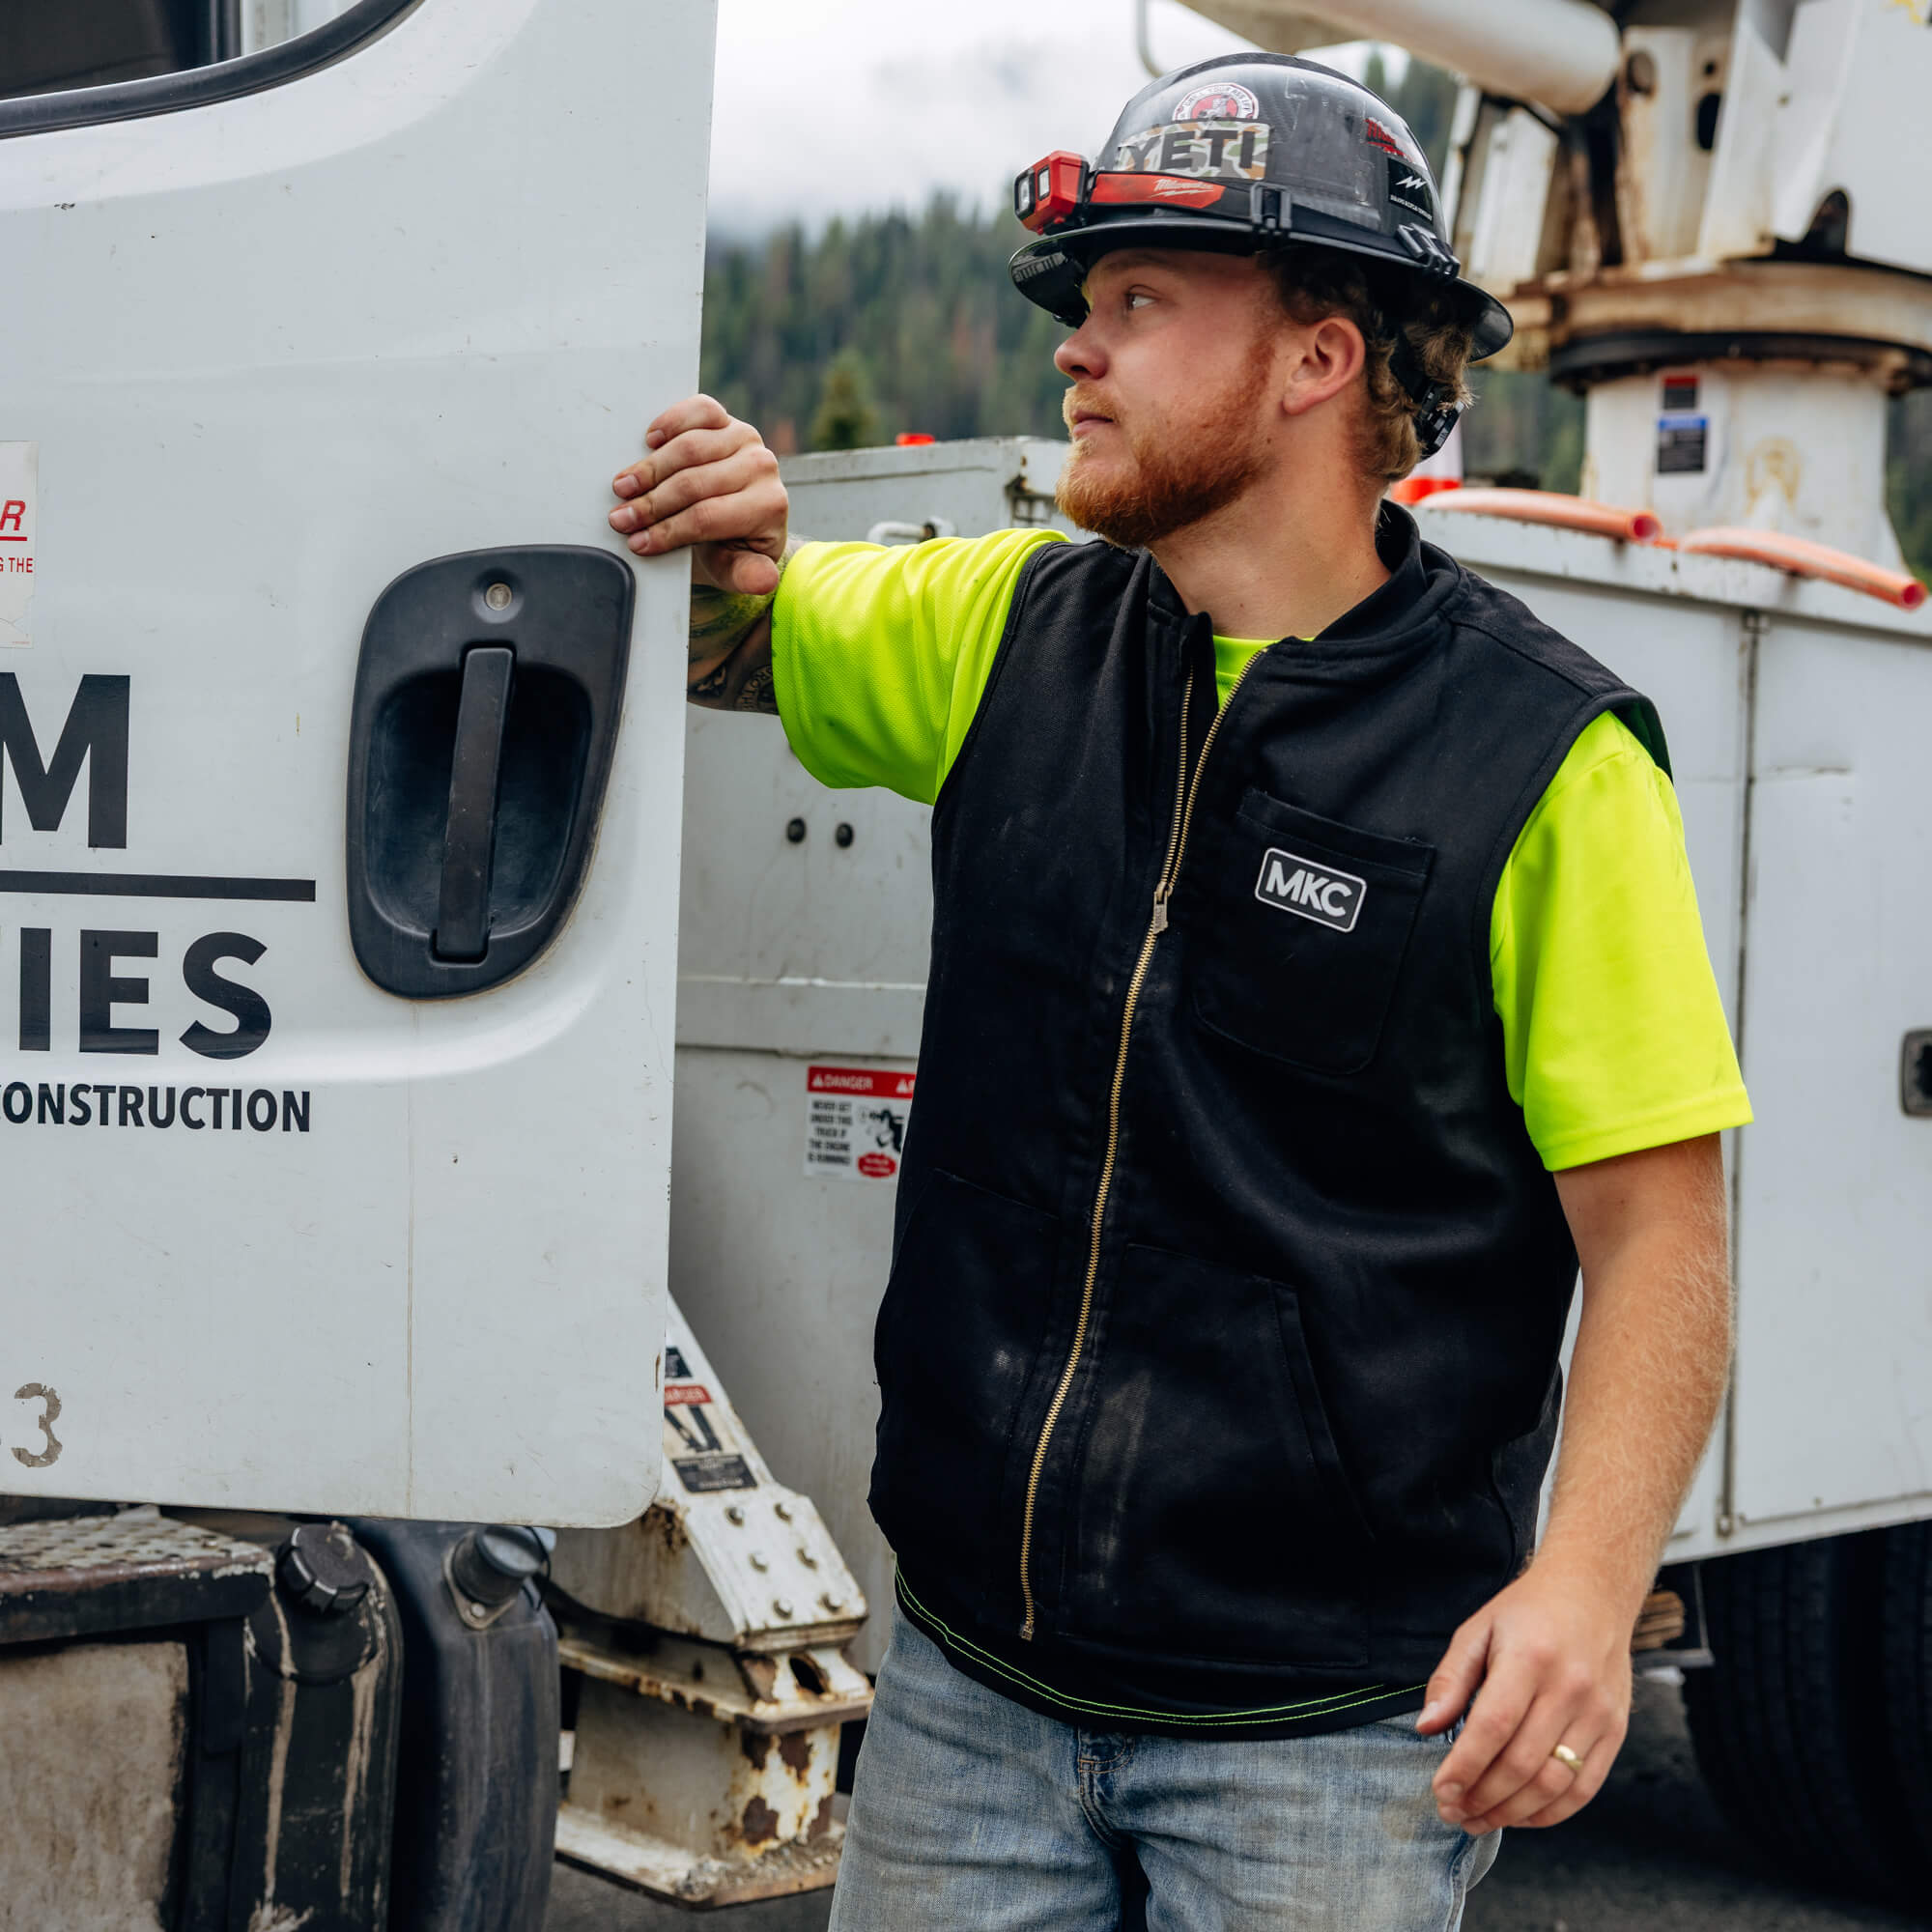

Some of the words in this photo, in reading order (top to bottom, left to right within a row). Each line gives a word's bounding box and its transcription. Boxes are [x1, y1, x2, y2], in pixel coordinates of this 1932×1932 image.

[1119, 129, 1258, 171] YETI
[0, 499, 26, 531] R
[8, 557, 34, 573] THE
[0, 672, 130, 848] M
[1265, 860, 1352, 917] MKC
[19, 926, 271, 1060] IES
[823, 1074, 873, 1090] DANGER
[0, 1081, 310, 1132] ONSTRUCTION
